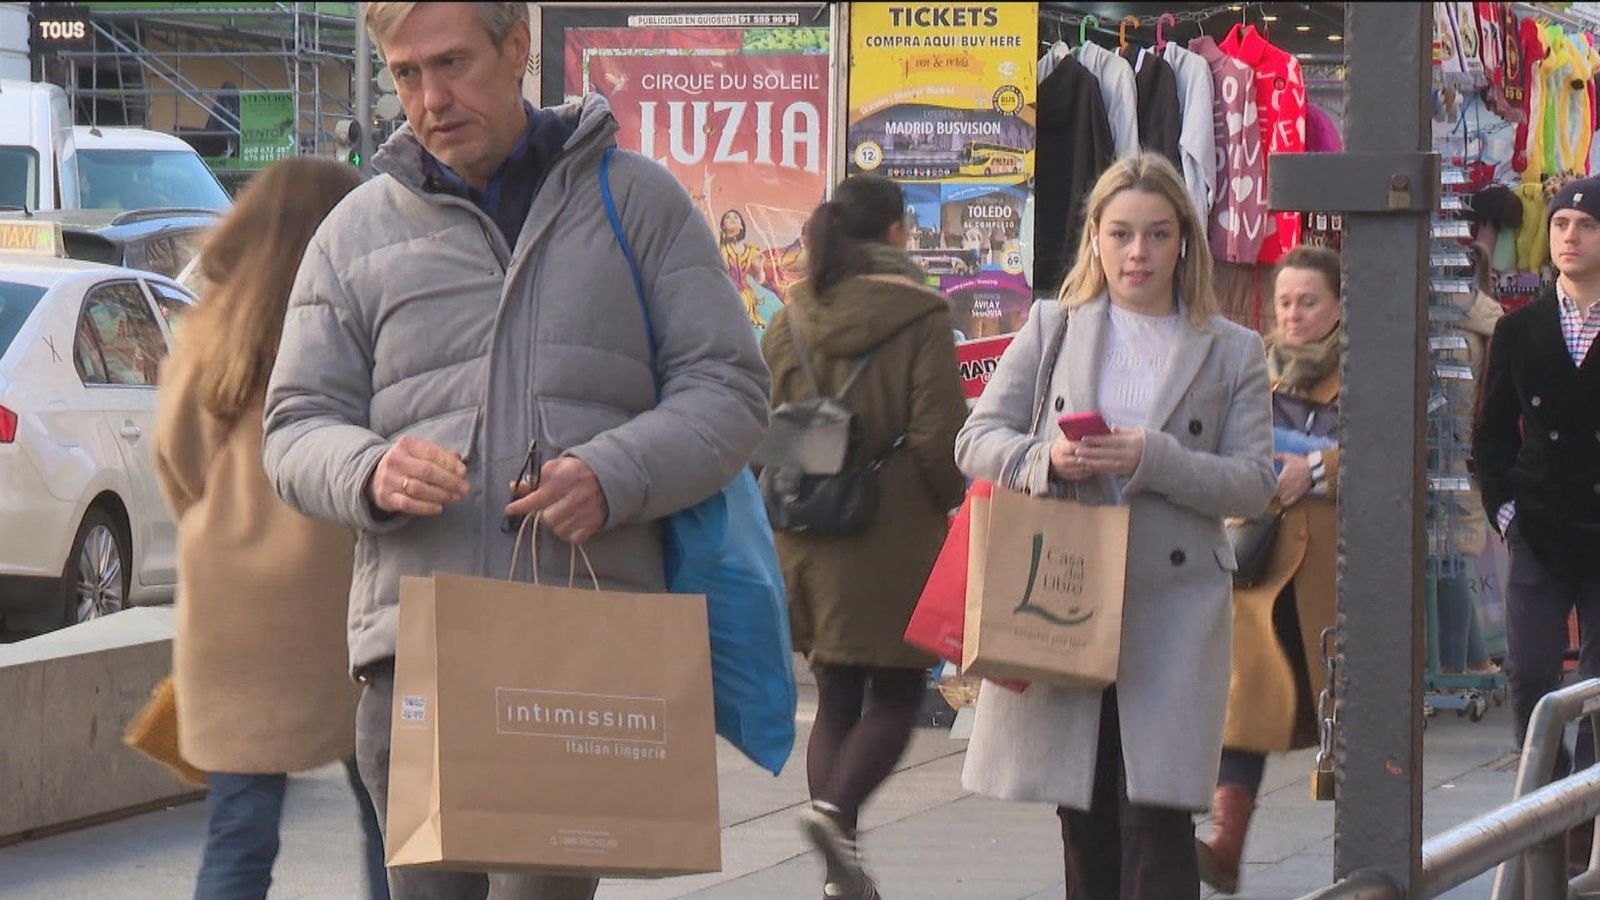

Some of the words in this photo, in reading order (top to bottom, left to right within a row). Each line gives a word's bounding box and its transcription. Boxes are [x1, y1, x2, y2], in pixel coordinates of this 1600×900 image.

[638, 15, 683, 25] PUBLICIDAD
[685, 15, 696, 25] EN
[697, 15, 737, 25] QUIOSCOS
[888, 7, 998, 27] TICKETS
[39, 21, 85, 40] TOUS
[866, 36, 920, 48] COMPRA
[923, 36, 955, 48] AQUI
[960, 36, 986, 48] BUY
[990, 36, 1022, 48] HERE
[641, 74, 714, 95] CIRQUE
[720, 74, 748, 90] DU
[752, 74, 819, 90] SOLEIL
[638, 101, 820, 175] LUZIA
[885, 121, 934, 135] MADRID
[936, 121, 1001, 135] BUSVISION
[968, 205, 1012, 218] TOLEDO
[2, 224, 36, 247] TAXI
[959, 356, 1001, 380] MAD
[507, 703, 656, 731] intimissimi
[566, 740, 609, 756] Italian
[613, 742, 666, 760] lingerie
